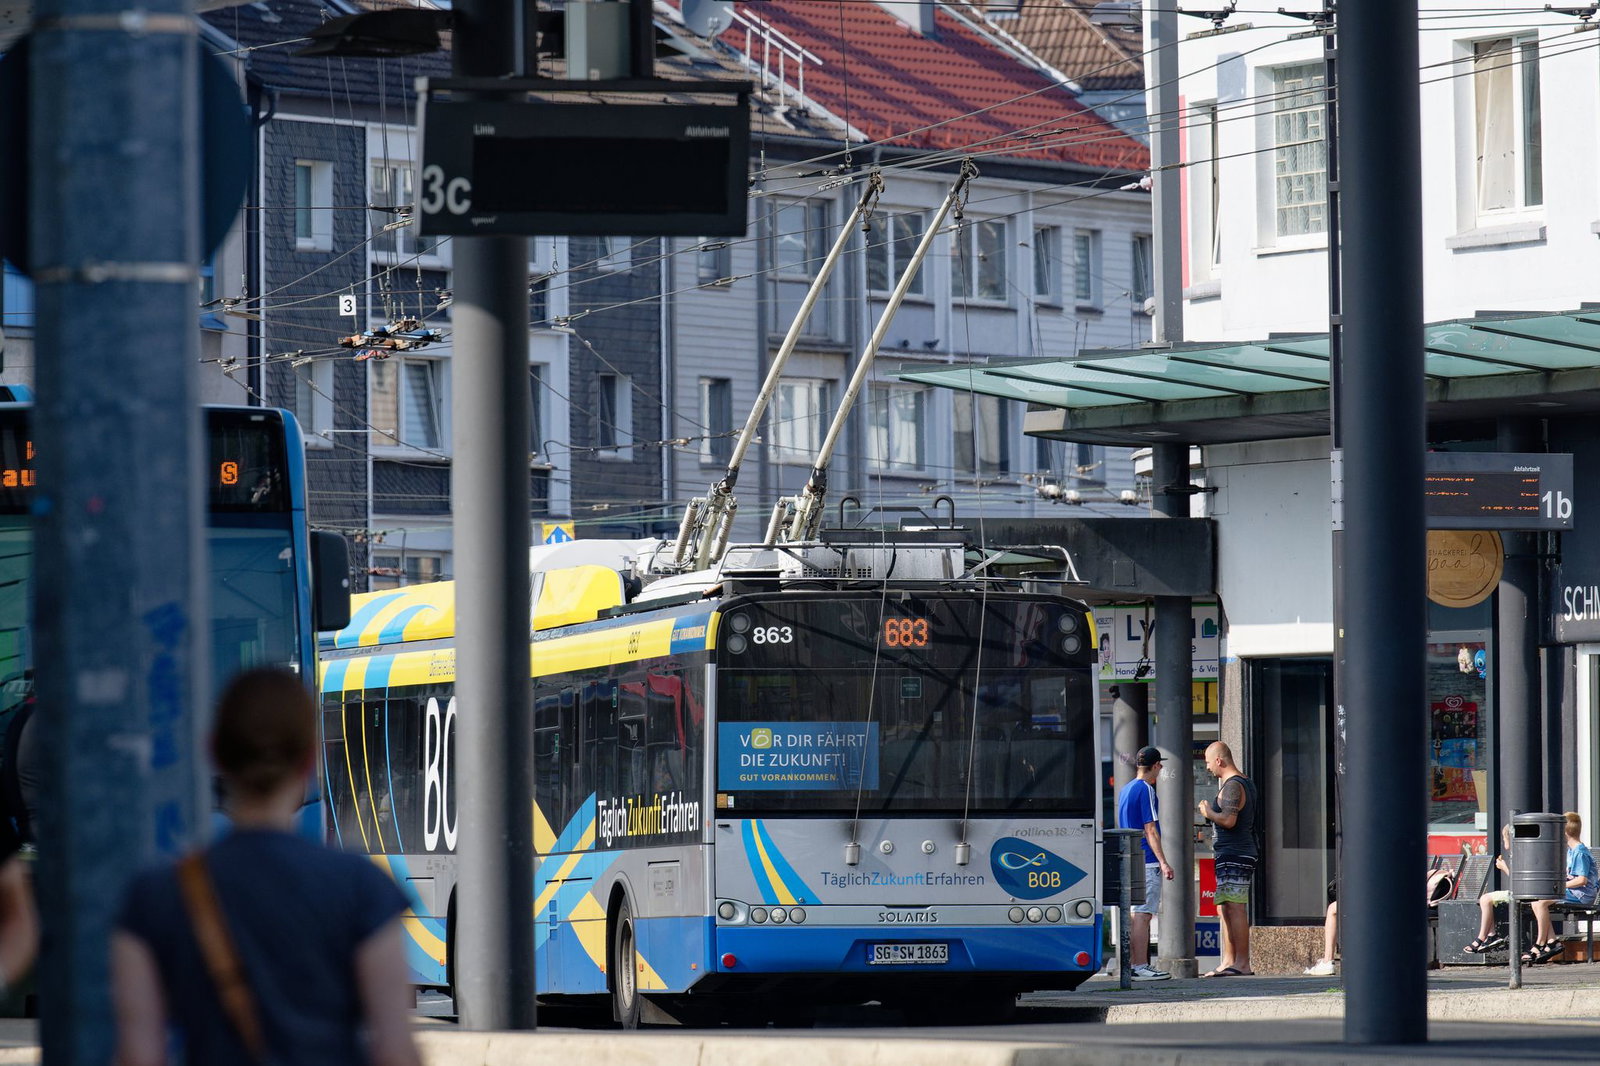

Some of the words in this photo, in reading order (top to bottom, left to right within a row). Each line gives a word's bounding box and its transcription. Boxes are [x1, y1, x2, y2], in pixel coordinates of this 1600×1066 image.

[421, 164, 472, 215] 3c
[344, 299, 353, 313] 3
[1542, 490, 1573, 519] 1b
[753, 626, 793, 645] 863
[885, 617, 928, 647] 683
[788, 734, 812, 747] DIR
[818, 732, 865, 747] FÄHRT
[741, 754, 765, 767] DIE
[769, 753, 846, 767] ZUKUNFT!
[739, 773, 758, 782] GUT
[761, 773, 839, 782] VORANKOMMEN.
[821, 871, 985, 888] TäglichZukunftErfahren
[1028, 871, 1061, 888] BOB
[878, 912, 938, 923] SOLARIS
[1194, 930, 1220, 949] 1&1
[876, 946, 891, 960] SG
[900, 946, 915, 960] SW
[917, 945, 946, 960] 1863
